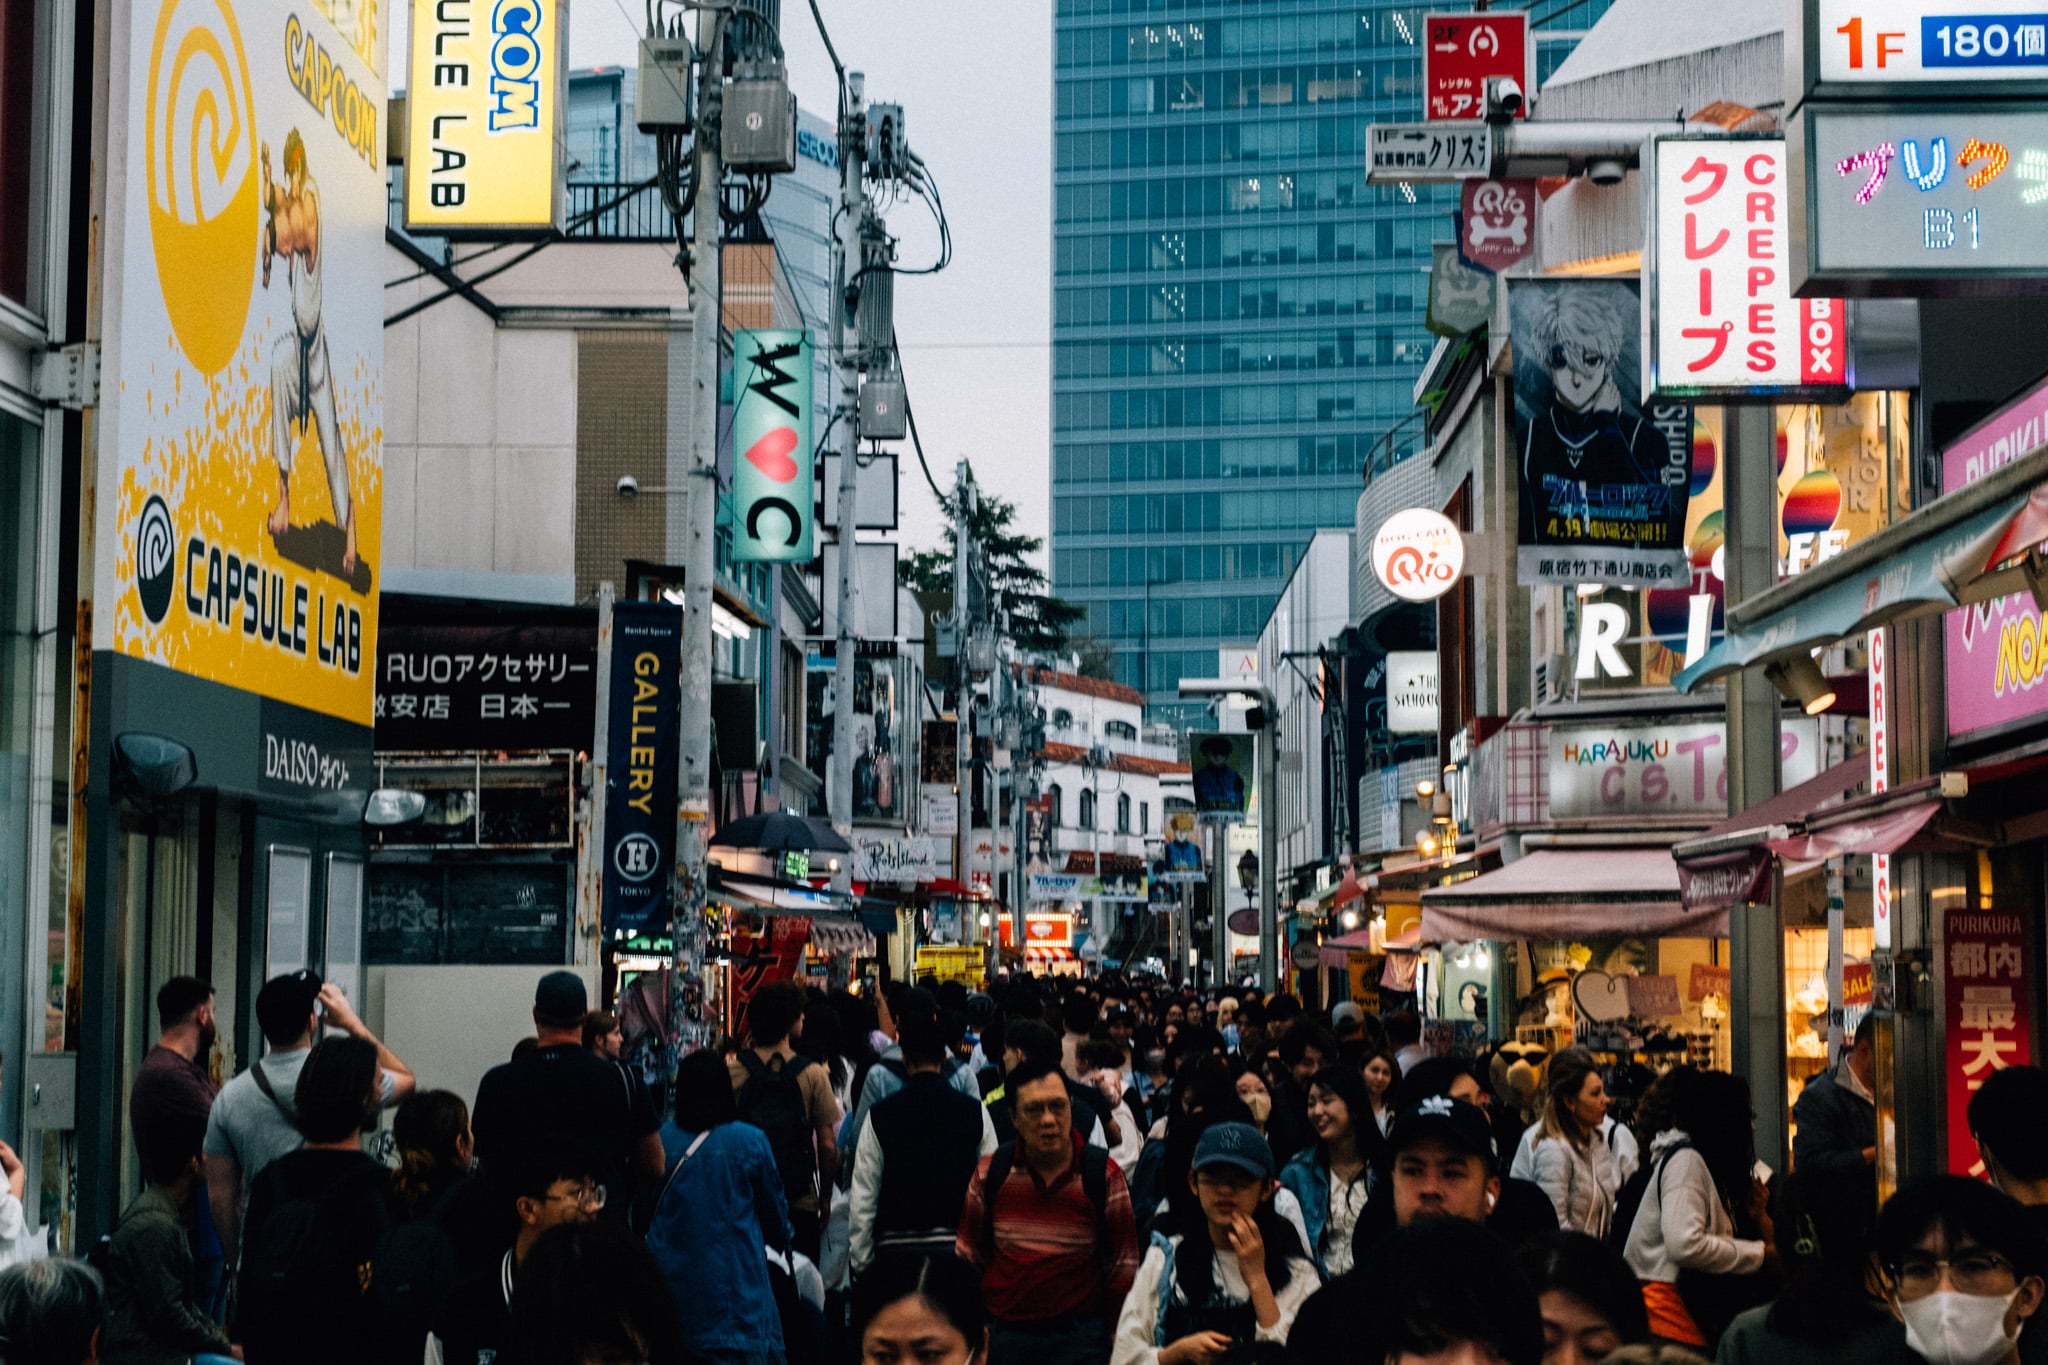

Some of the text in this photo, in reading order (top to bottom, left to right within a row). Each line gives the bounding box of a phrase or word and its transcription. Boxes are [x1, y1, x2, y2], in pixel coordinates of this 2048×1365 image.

[489, 0, 542, 131] COM
[1837, 17, 1906, 69] 1F
[1936, 24, 2046, 58] 180個
[285, 12, 377, 173] CAPCOM
[431, 116, 467, 207] LAB
[1923, 208, 1979, 249] B1
[1681, 156, 1734, 373] クレープ
[1744, 154, 1776, 372] CREPES
[747, 344, 800, 420] W
[746, 496, 802, 547] C
[1547, 517, 1582, 539] 4.19
[1386, 546, 1454, 586] Rio
[1539, 558, 1673, 579] 原宿竹下通り商店会
[186, 537, 362, 675] CAPSULE LAB
[480, 694, 571, 720] 日本一
[628, 651, 661, 816] GALLERY
[1564, 738, 1669, 766] HARAJUKU
[265, 733, 319, 786] DAISO
[619, 885, 651, 897] TOKYO
[1950, 914, 2022, 935] PURIKURA
[1951, 941, 2022, 978] 都内
